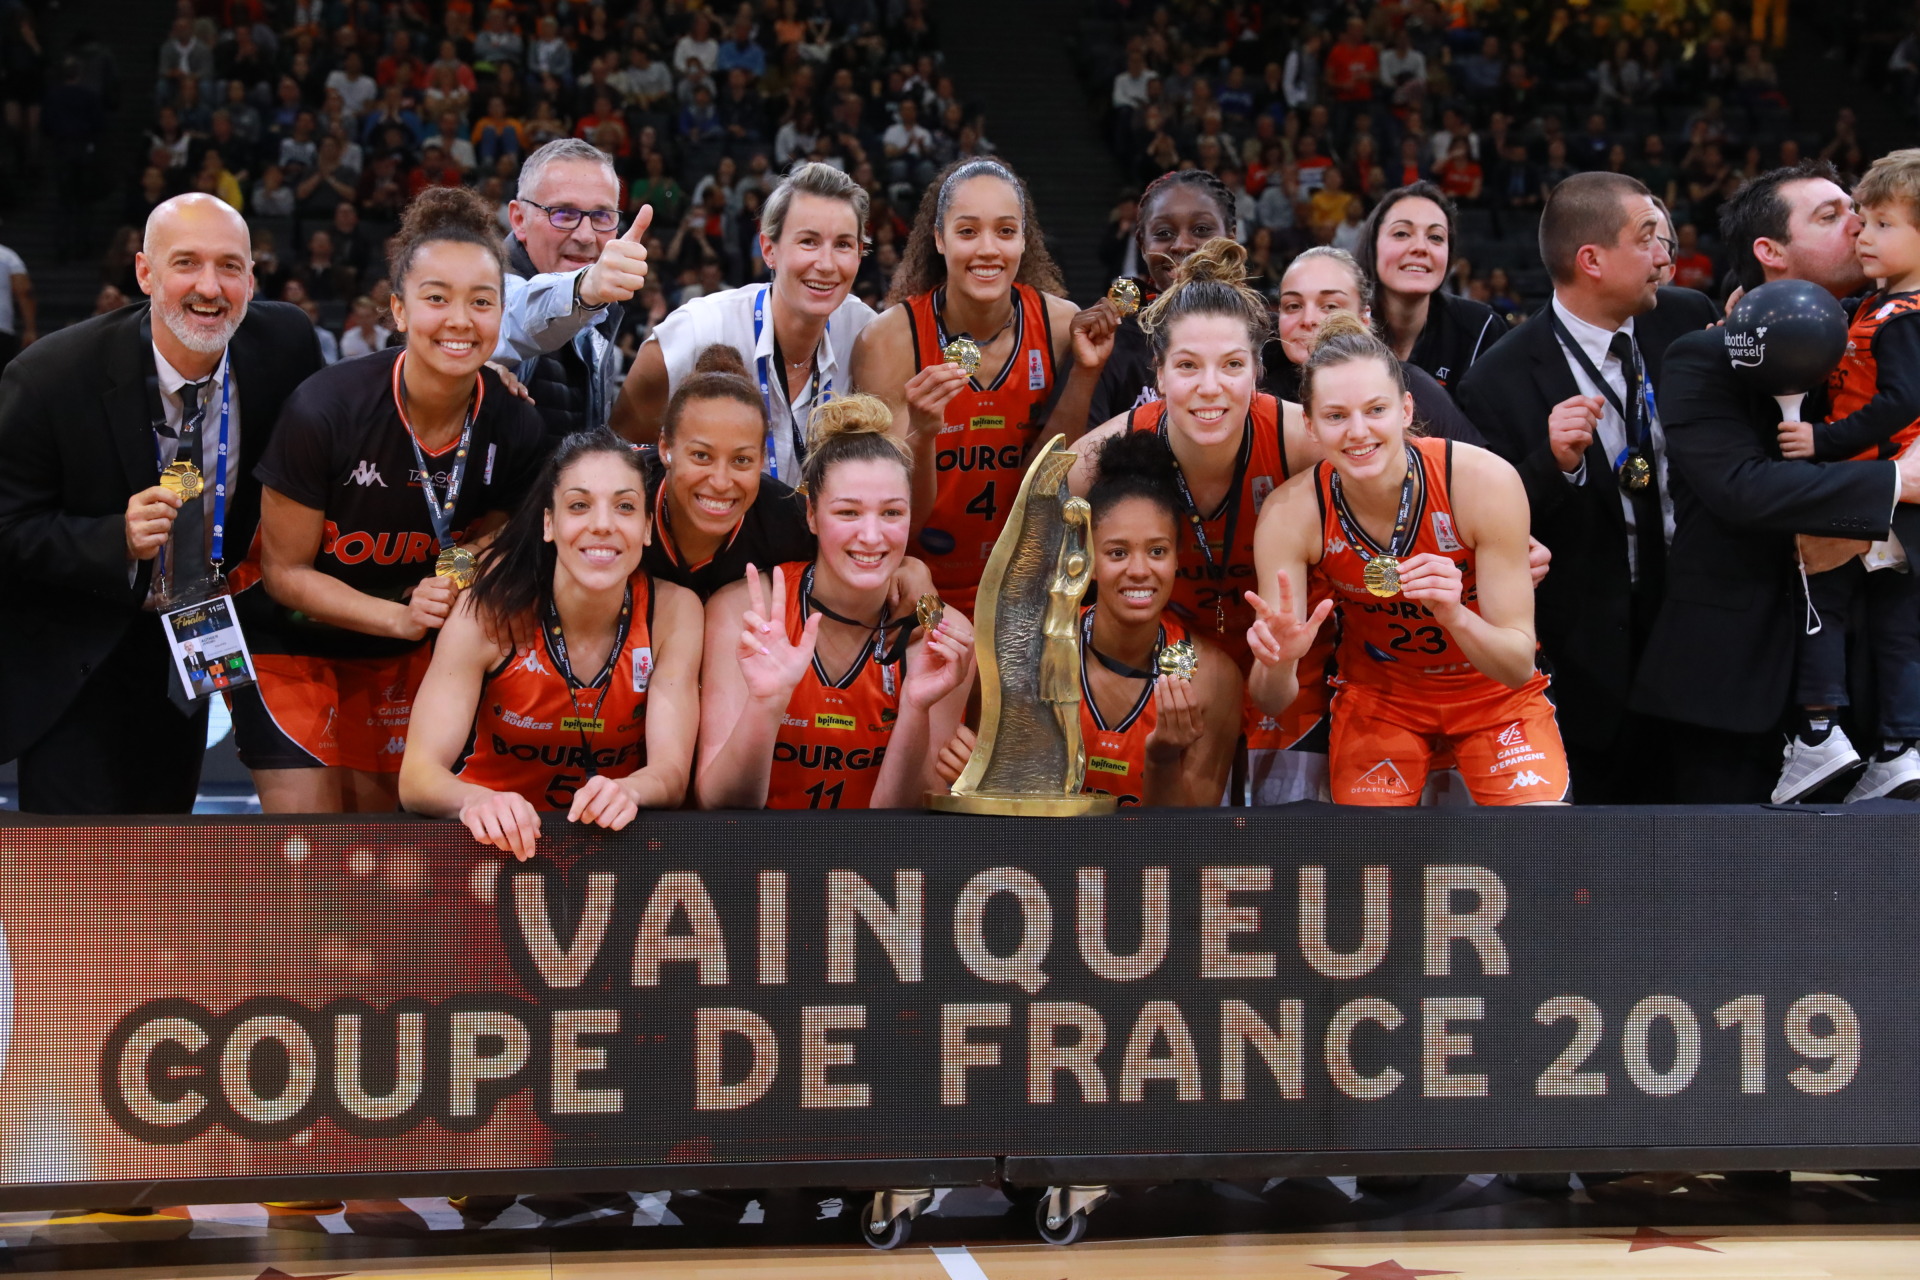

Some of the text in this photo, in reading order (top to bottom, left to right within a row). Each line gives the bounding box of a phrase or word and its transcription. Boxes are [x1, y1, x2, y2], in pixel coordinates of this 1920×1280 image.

[1728, 343, 1766, 362] yourself
[965, 480, 997, 521] 4
[1388, 623, 1448, 655] 23
[502, 715, 554, 730] BOURGES
[817, 716, 854, 726] bpifrance
[773, 742, 887, 771] OURGE
[1091, 759, 1127, 772] bpifrance
[1490, 752, 1546, 773] D'EPARGNE
[1497, 744, 1532, 760] CAISSE
[545, 774, 581, 809] 5
[805, 778, 845, 809] 11
[512, 864, 1510, 994] VAINQUEUR
[118, 992, 1862, 1126] COUPE DE FRANCE 2019
